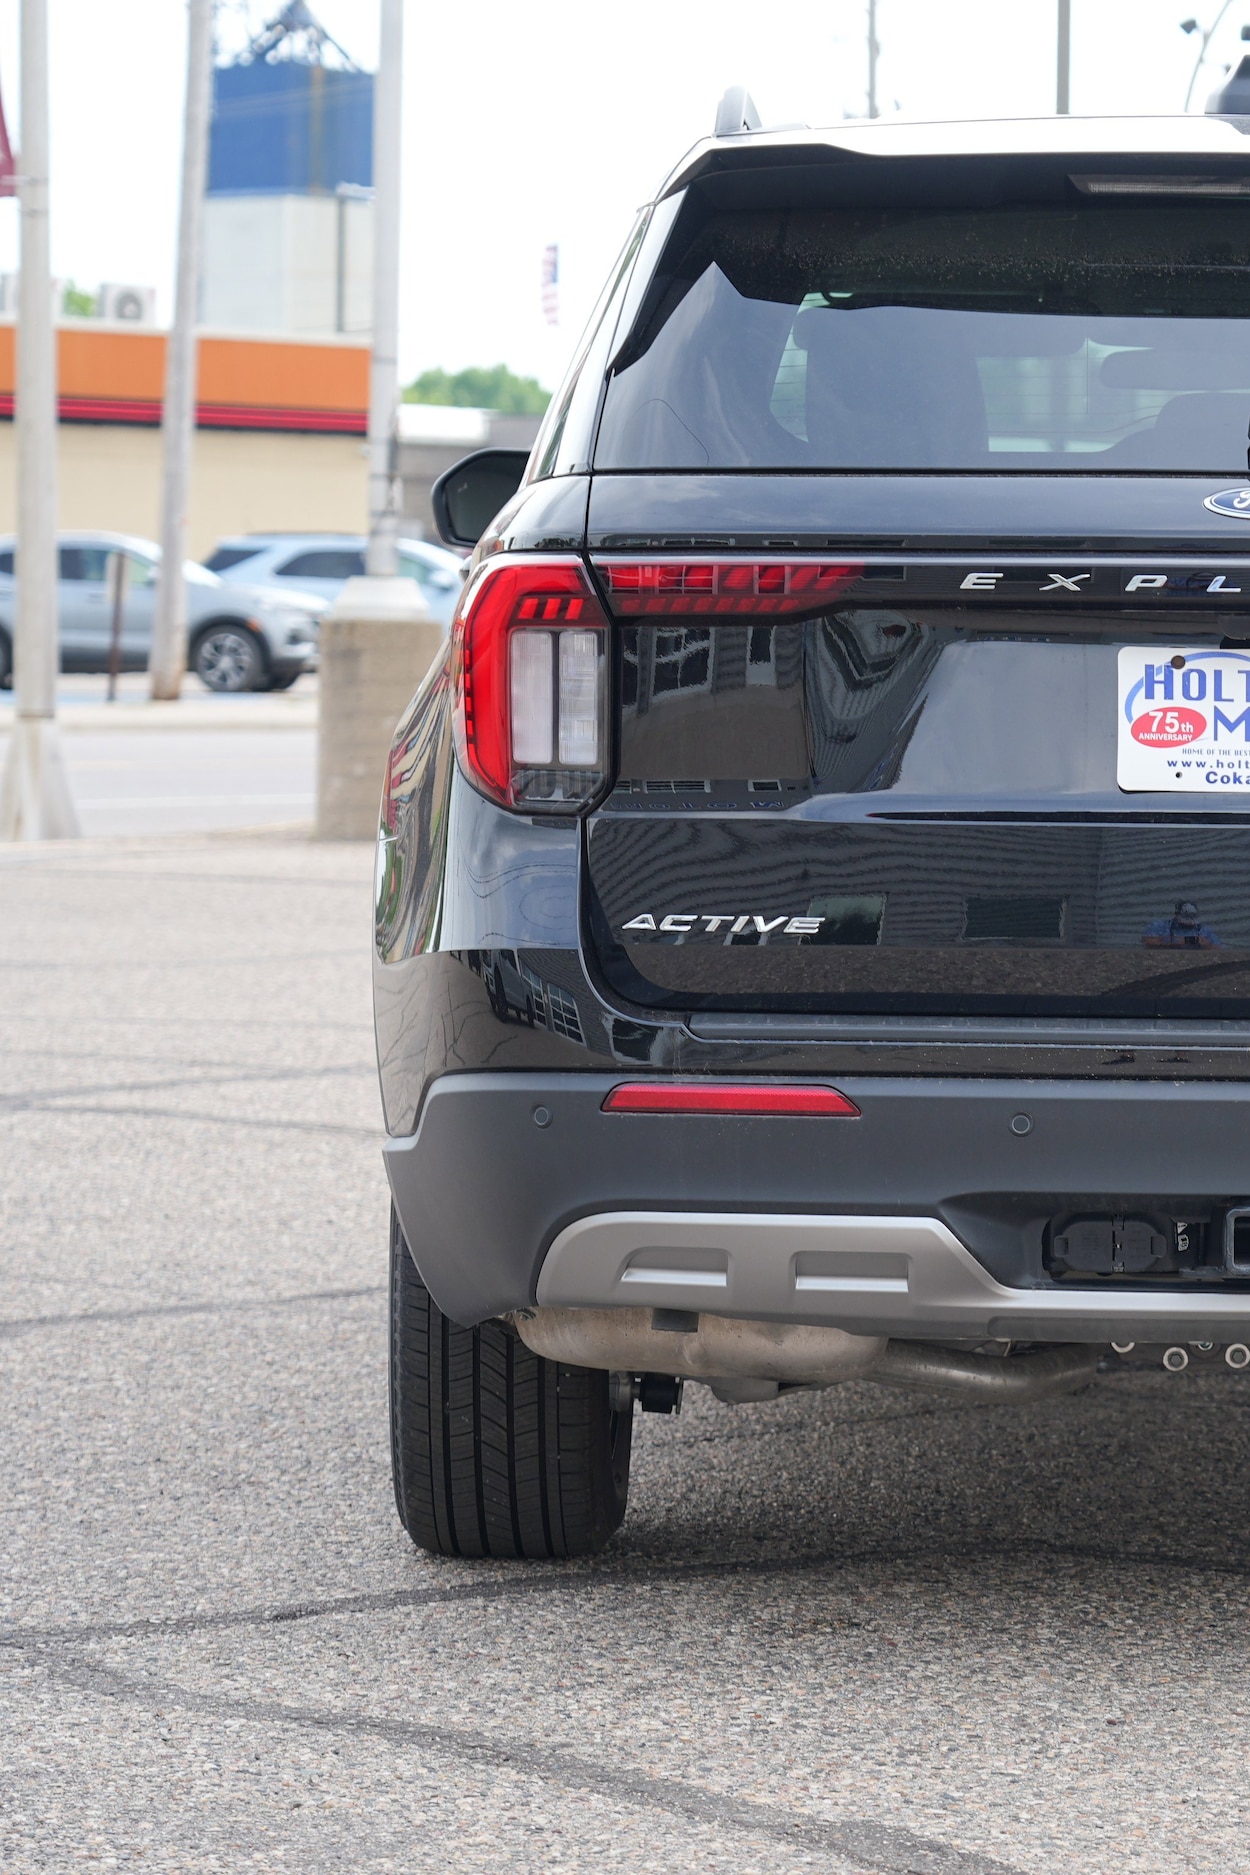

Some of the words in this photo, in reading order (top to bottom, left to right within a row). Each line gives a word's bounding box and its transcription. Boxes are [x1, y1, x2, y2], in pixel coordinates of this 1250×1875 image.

[1148, 711, 1194, 734] 75th
[1138, 732, 1193, 742] ANNIVERSARY
[1182, 748, 1204, 756] HOME
[1206, 748, 1215, 756] OF
[1218, 749, 1232, 757] THE
[621, 913, 826, 934] ACTIVE
